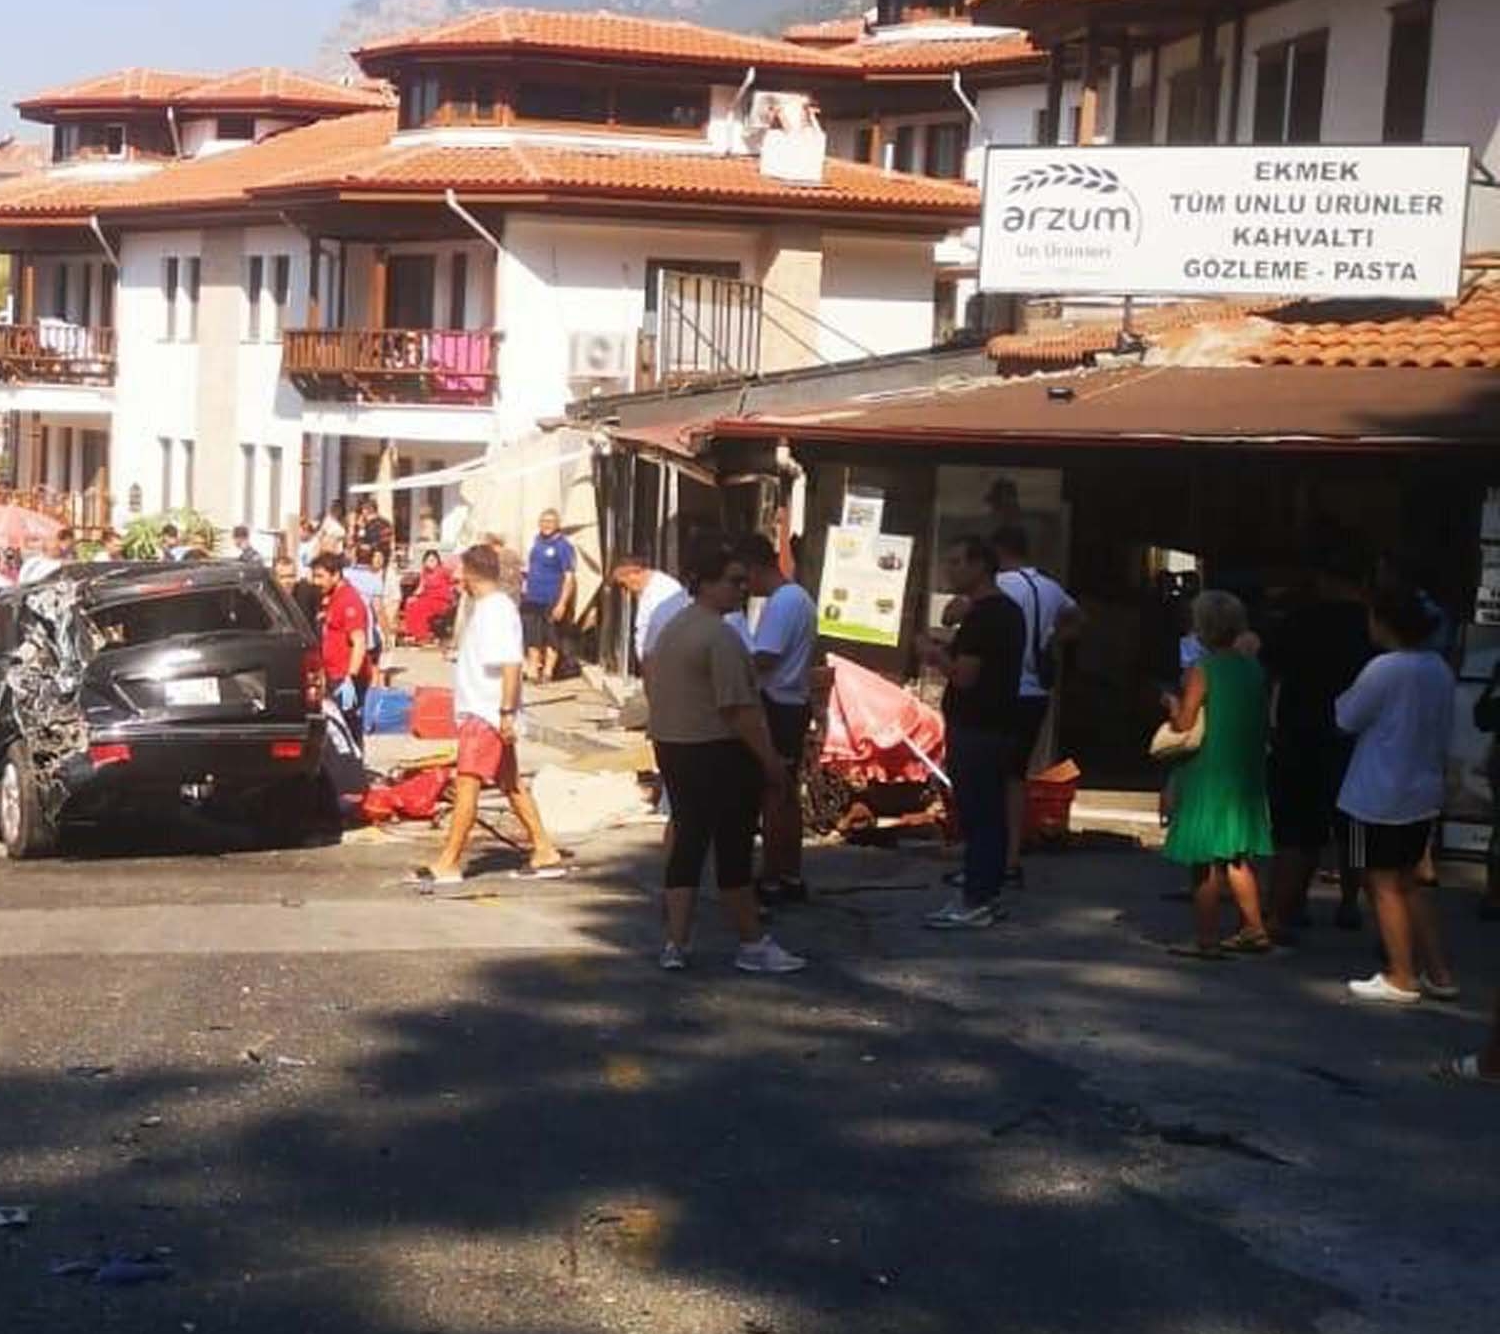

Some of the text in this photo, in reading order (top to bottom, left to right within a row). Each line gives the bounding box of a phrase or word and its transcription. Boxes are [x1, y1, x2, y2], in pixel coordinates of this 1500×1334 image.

[1254, 161, 1359, 182] EKMEK
[1169, 190, 1444, 216] TÜM UNLU ÜRÜNLER
[1002, 205, 1132, 233] arzum
[1232, 227, 1374, 248] KAHVALTI
[1333, 261, 1418, 282] PASTA
